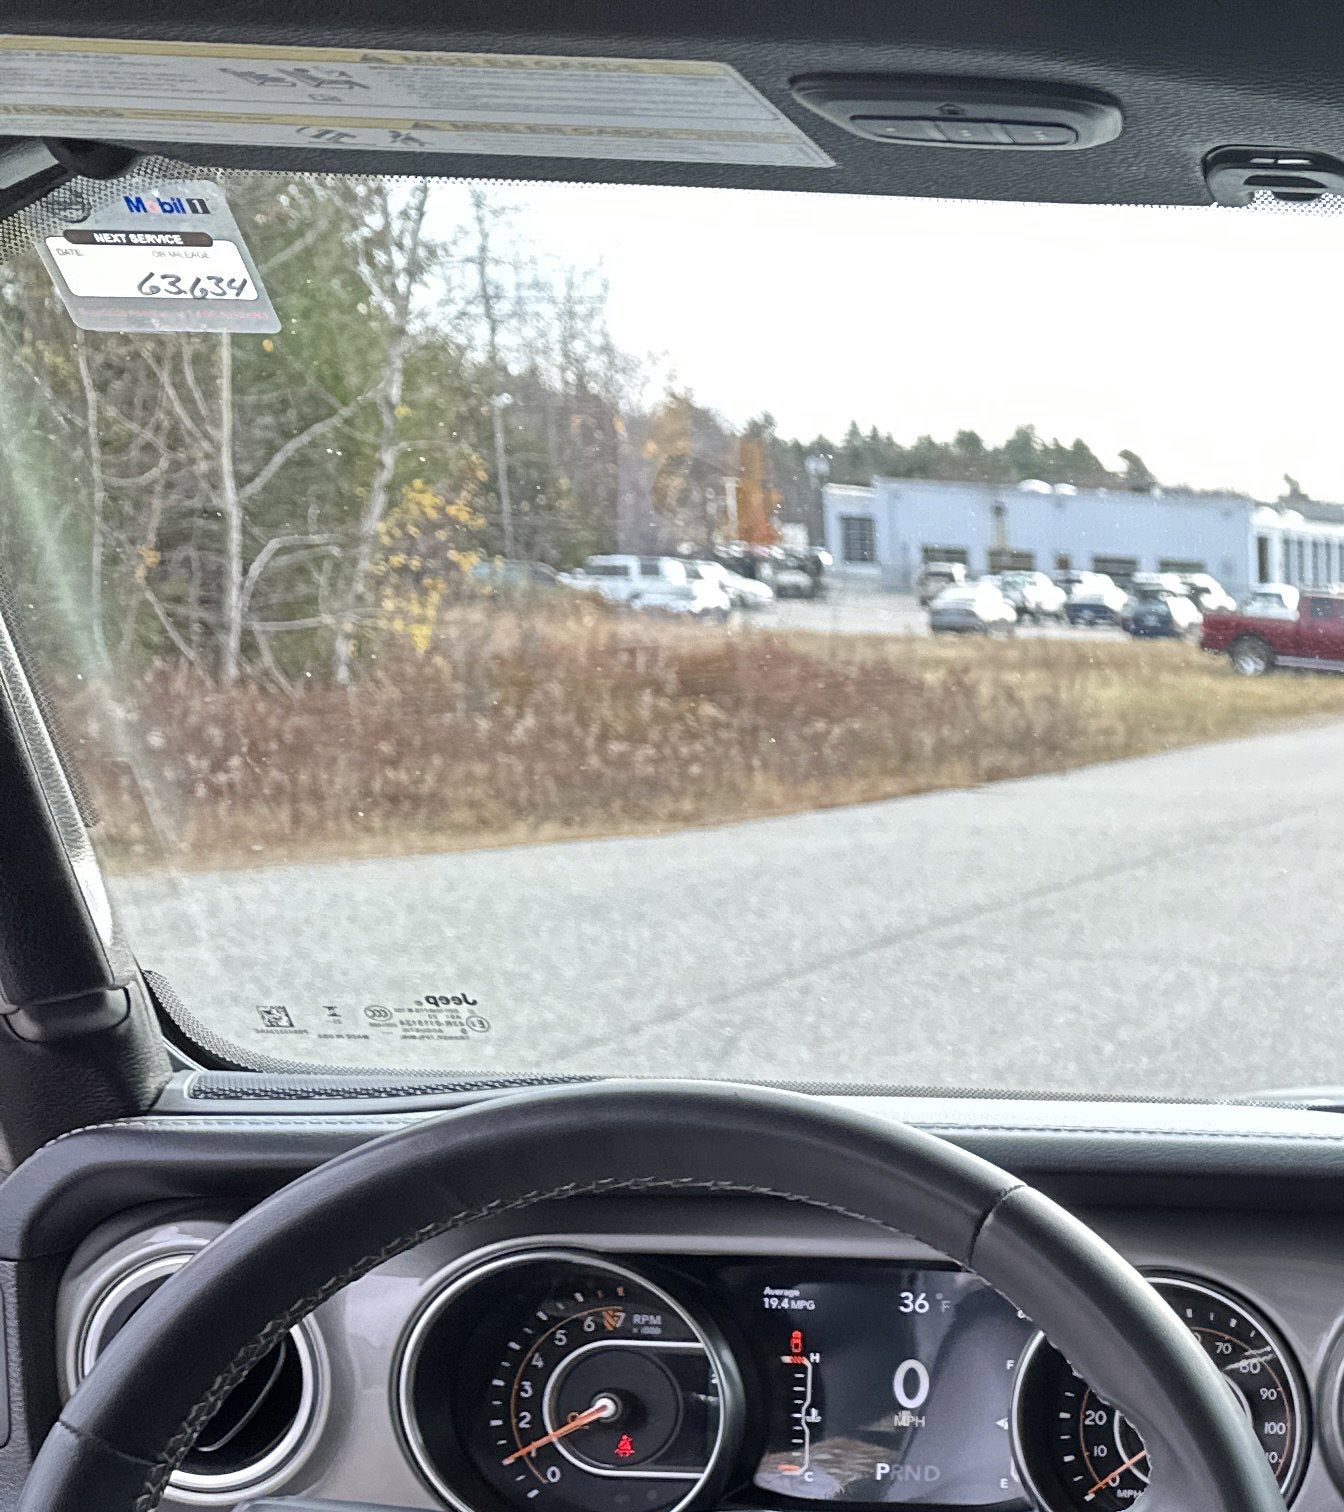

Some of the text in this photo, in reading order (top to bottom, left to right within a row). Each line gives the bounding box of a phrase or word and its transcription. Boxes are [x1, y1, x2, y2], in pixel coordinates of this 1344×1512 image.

[123, 196, 186, 214] Mobil
[93, 233, 184, 245] NEXT SERVICE
[764, 1287, 800, 1297] Average
[763, 1298, 816, 1311] 19.4 MPG
[899, 1292, 929, 1313] 36
[583, 1316, 595, 1332] 6
[614, 1312, 626, 1328] 7
[632, 1314, 662, 1325] RPM
[554, 1330, 567, 1345] 5
[1215, 1342, 1232, 1354] 70
[531, 1353, 544, 1369] 4
[810, 1353, 820, 1363] H
[1006, 1360, 1015, 1370] F
[520, 1381, 533, 1398] 3
[893, 1359, 929, 1409] 0
[1259, 1388, 1277, 1400] 90
[518, 1412, 531, 1428] 2
[894, 1415, 926, 1427] MPH
[1084, 1411, 1106, 1425] 20
[1264, 1422, 1286, 1435] 100
[1093, 1445, 1107, 1457] 10
[547, 1466, 561, 1483] 0
[804, 1471, 814, 1482] C
[1000, 1478, 1008, 1488] E
